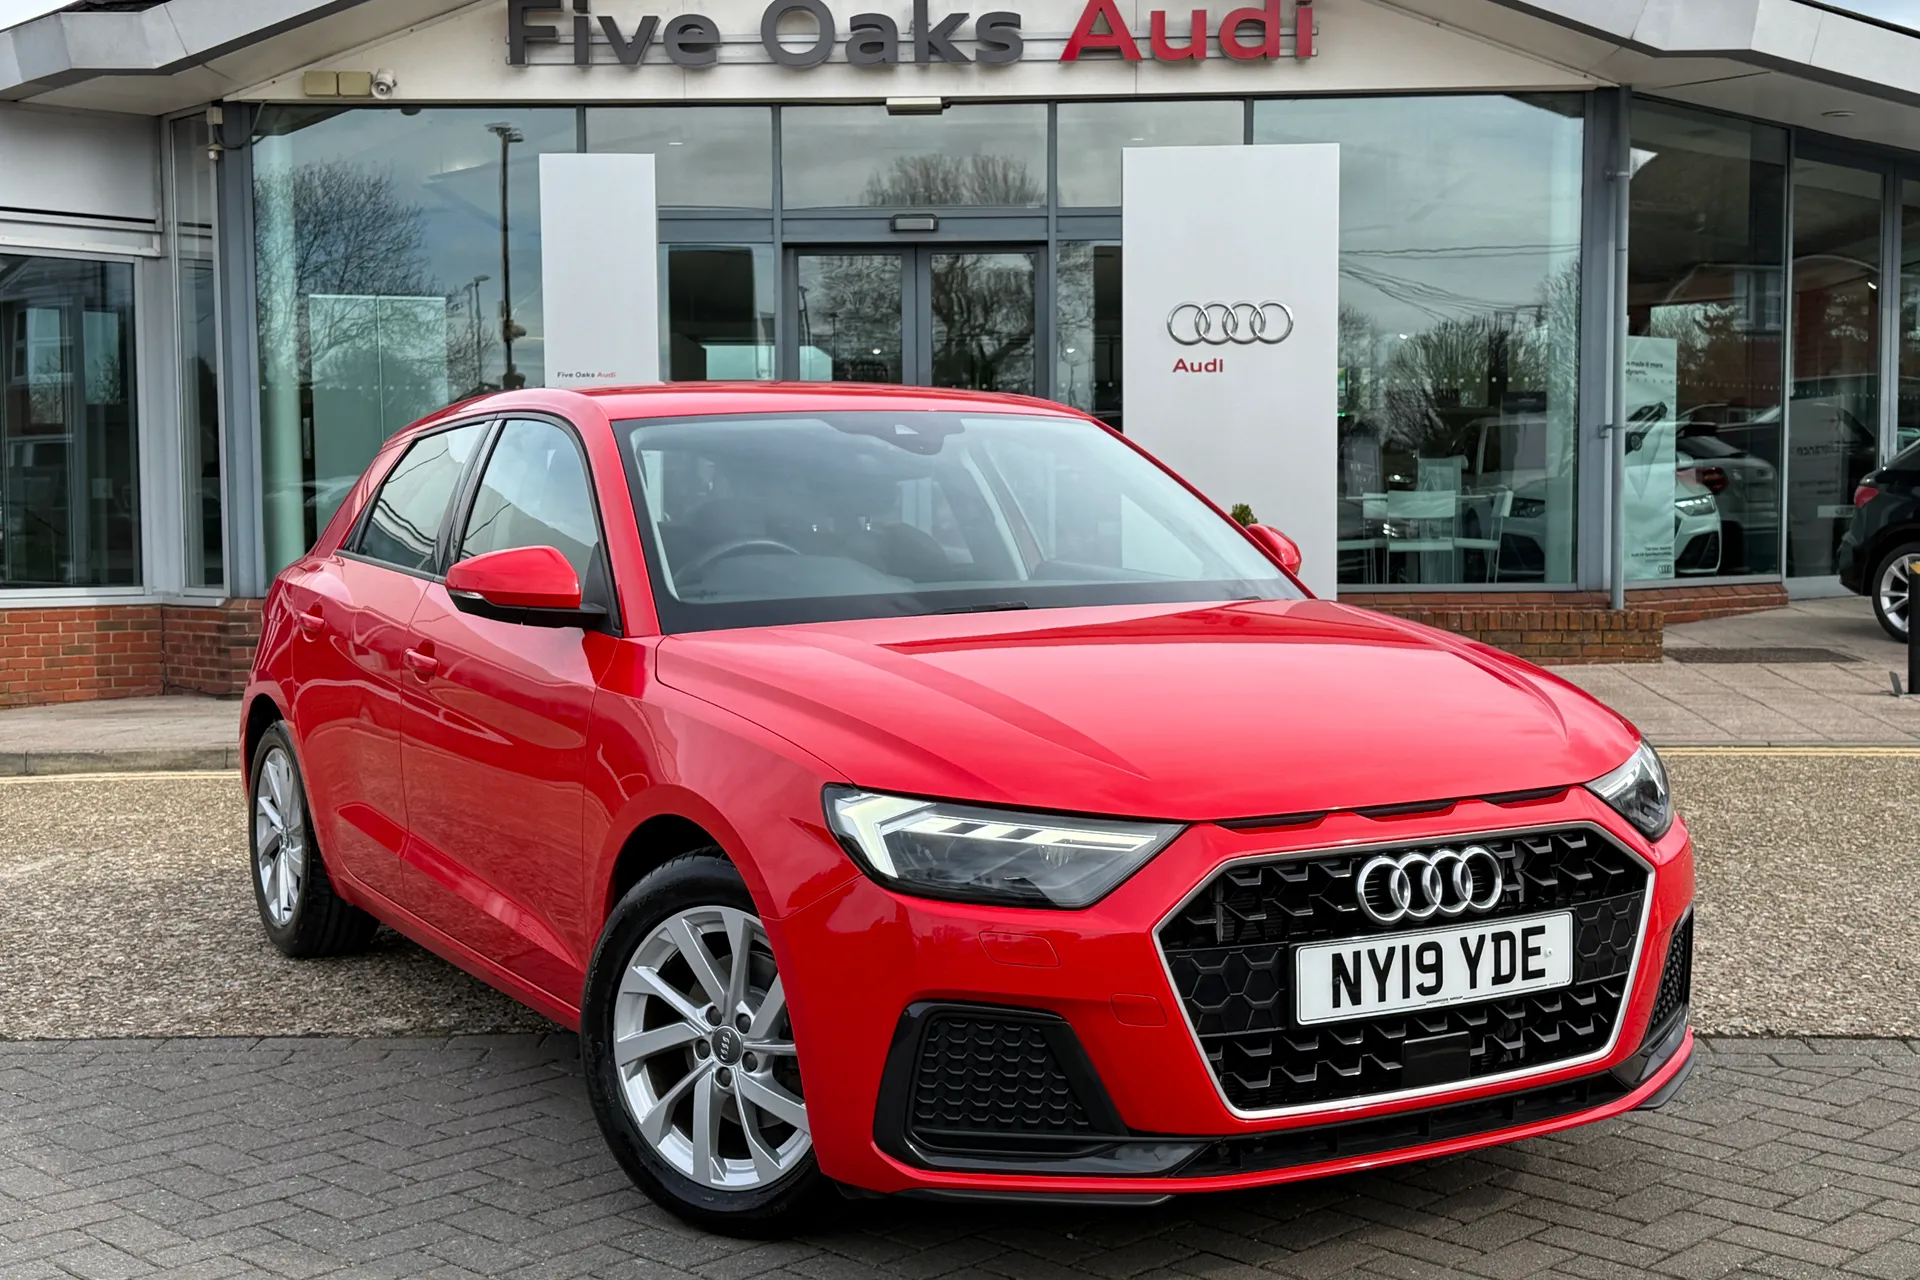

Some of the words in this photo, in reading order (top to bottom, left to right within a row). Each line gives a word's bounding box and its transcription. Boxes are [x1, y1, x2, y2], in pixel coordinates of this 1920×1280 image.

[507, 0, 722, 68] Five
[760, 0, 1025, 68] Oaks
[1059, 0, 1314, 63] Audi
[1172, 358, 1223, 373] Audi
[1331, 940, 1444, 1009] NY19
[1459, 924, 1546, 990] YDE
